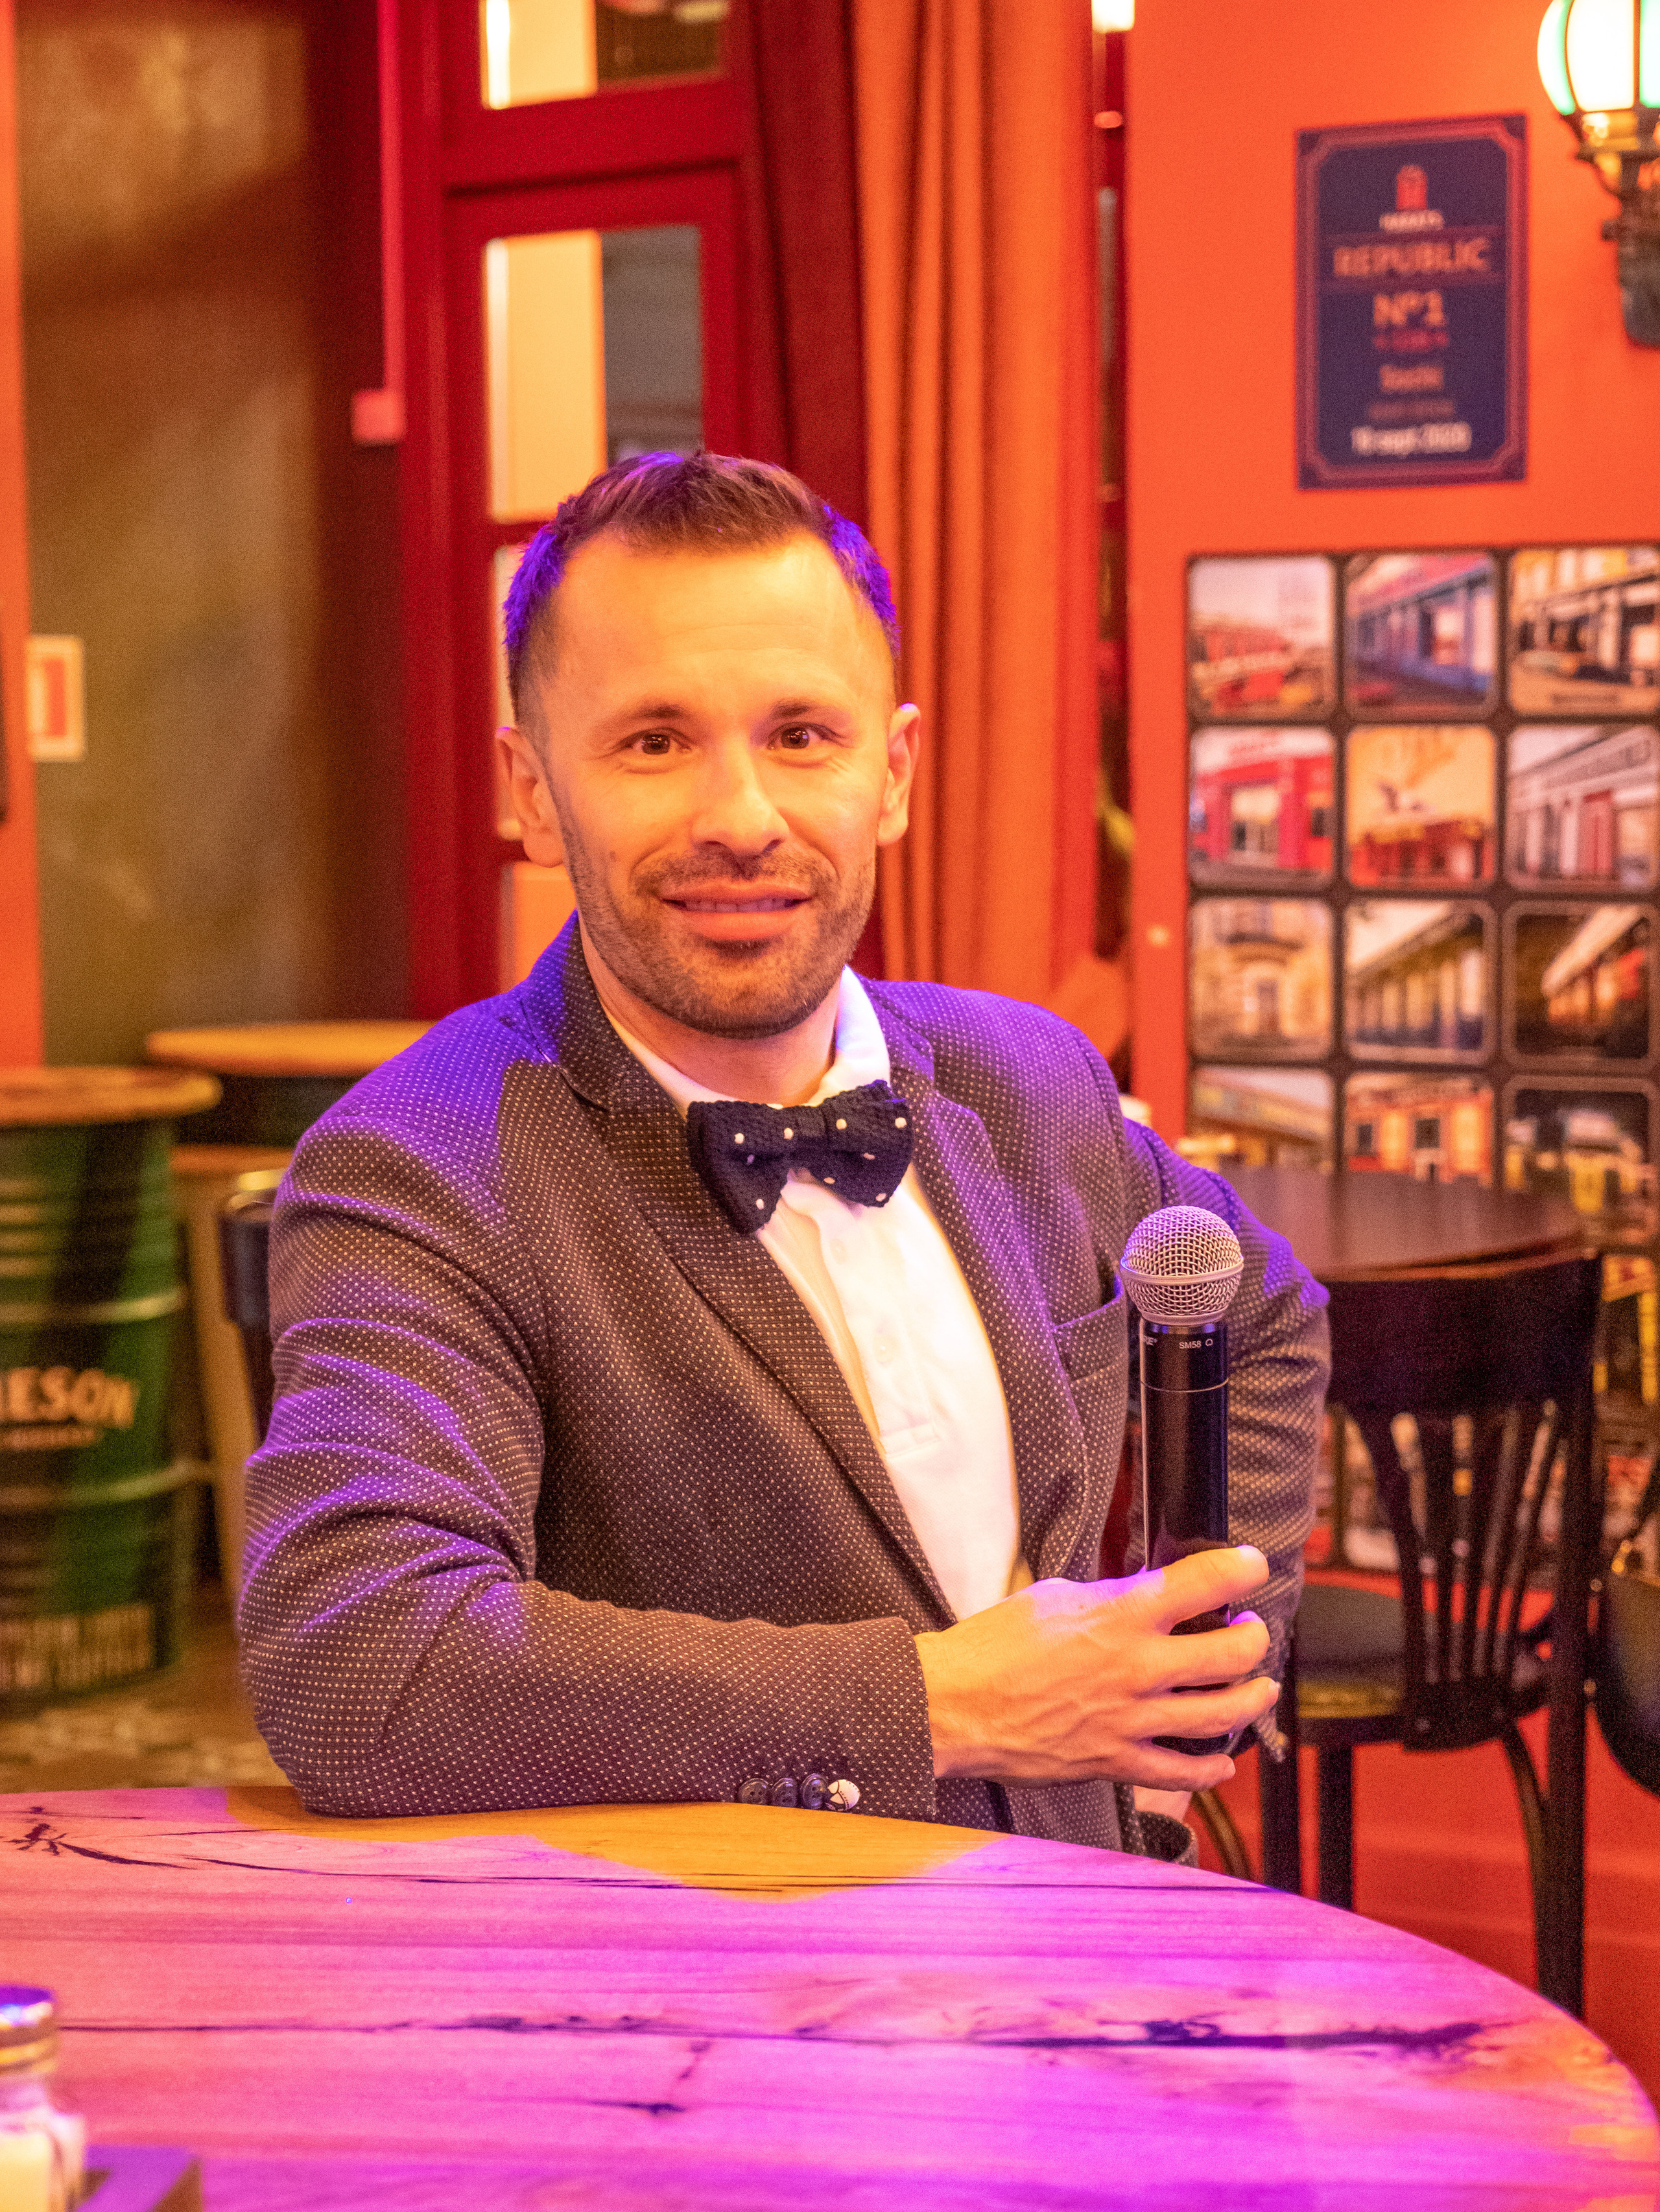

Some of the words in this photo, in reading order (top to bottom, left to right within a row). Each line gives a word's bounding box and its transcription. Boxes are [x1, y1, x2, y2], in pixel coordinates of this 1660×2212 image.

[1334, 238, 1490, 277] REPUBLIC
[1179, 1340, 1202, 1349] SM58
[0, 1366, 134, 1428] ESON
